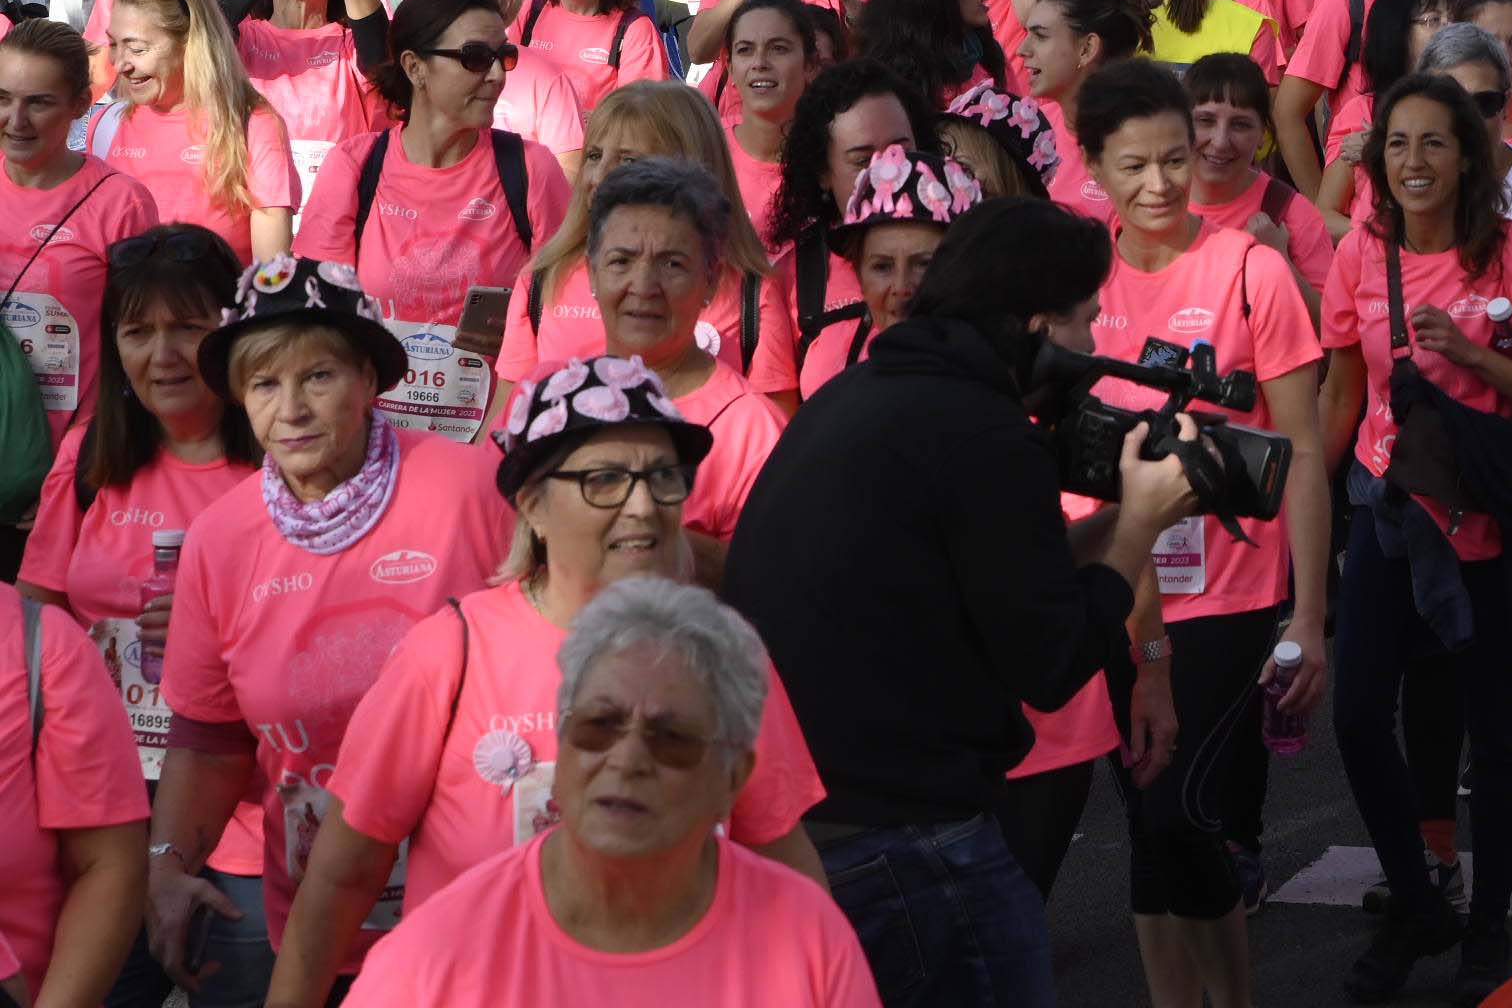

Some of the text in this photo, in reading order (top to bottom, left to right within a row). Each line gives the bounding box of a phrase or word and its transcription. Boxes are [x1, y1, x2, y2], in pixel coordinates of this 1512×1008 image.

[407, 391, 439, 403] 19666
[379, 400, 407, 411] CARRERA
[430, 408, 456, 416] MUJER
[130, 712, 171, 729] 16895
[257, 721, 309, 754] TU
